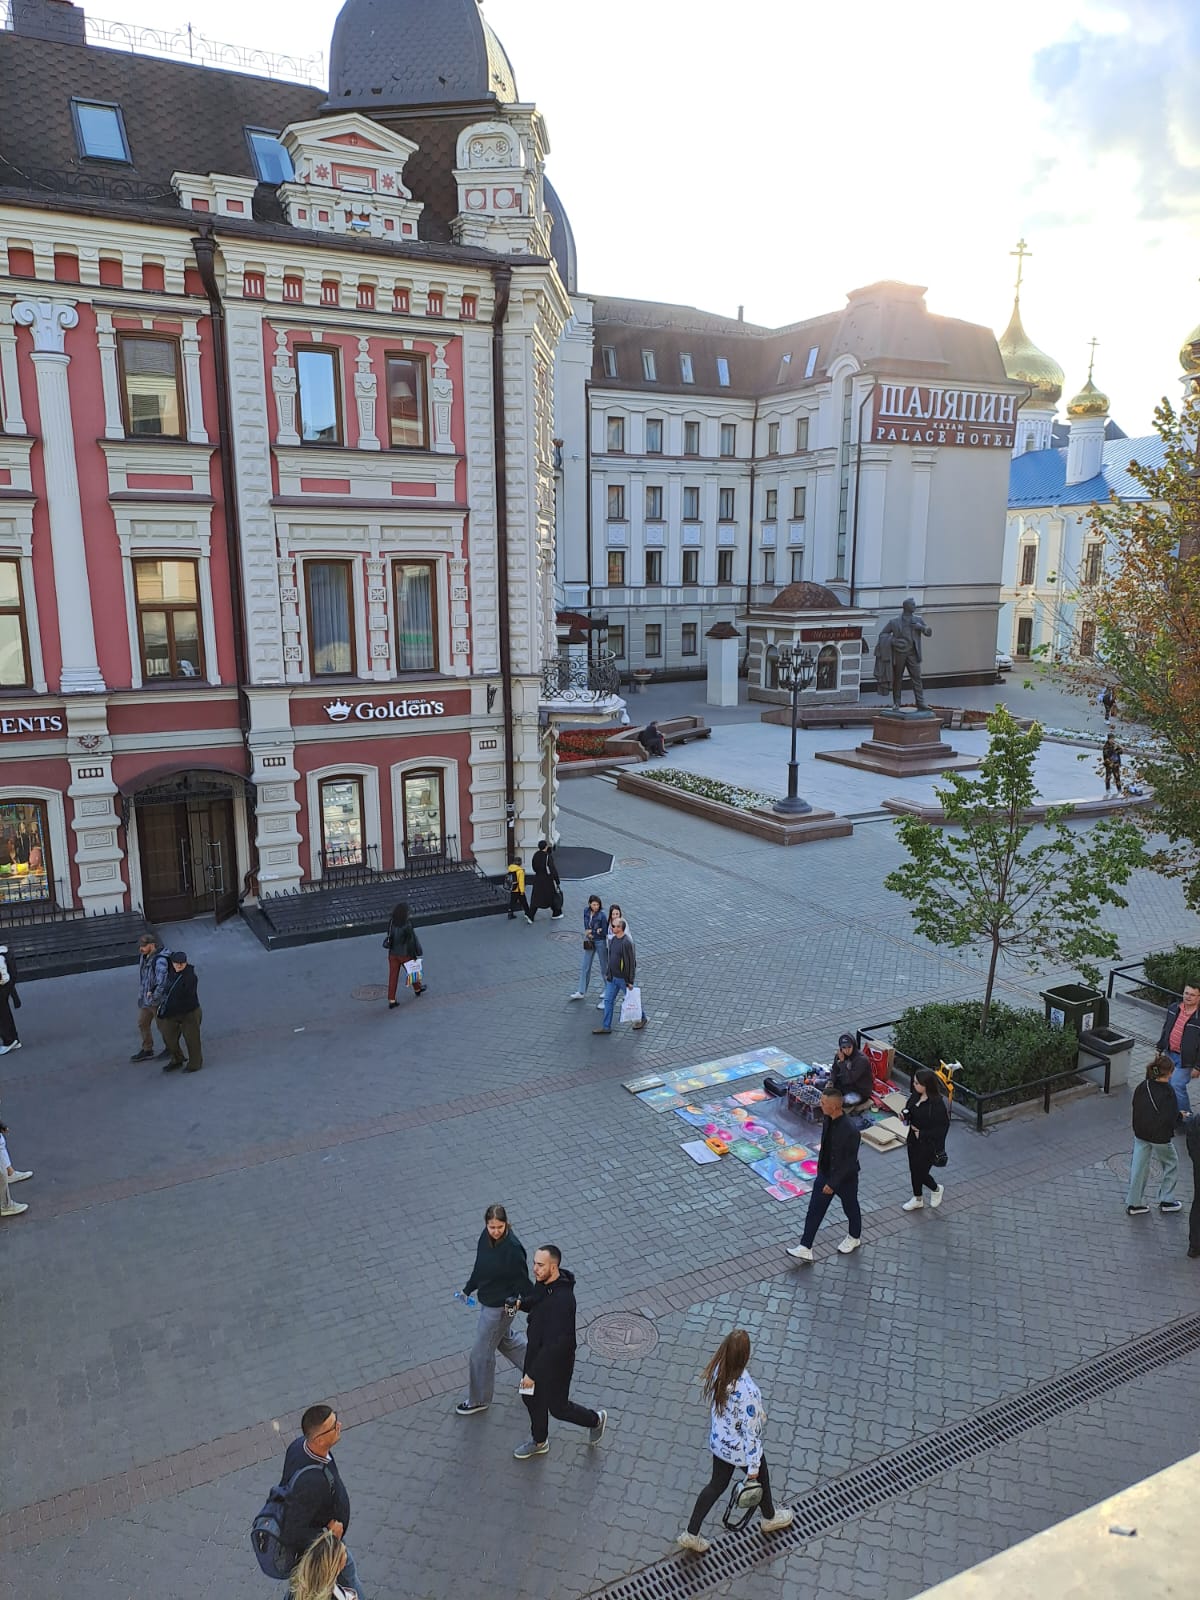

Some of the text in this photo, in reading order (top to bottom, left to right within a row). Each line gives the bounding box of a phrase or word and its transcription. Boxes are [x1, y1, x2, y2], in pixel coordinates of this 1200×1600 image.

[879, 385, 1016, 424] ШАЛЯПИН
[876, 426, 1013, 447] PALACE HOTEL
[355, 700, 444, 720] Golden's
[0, 715, 62, 734] ENTS
